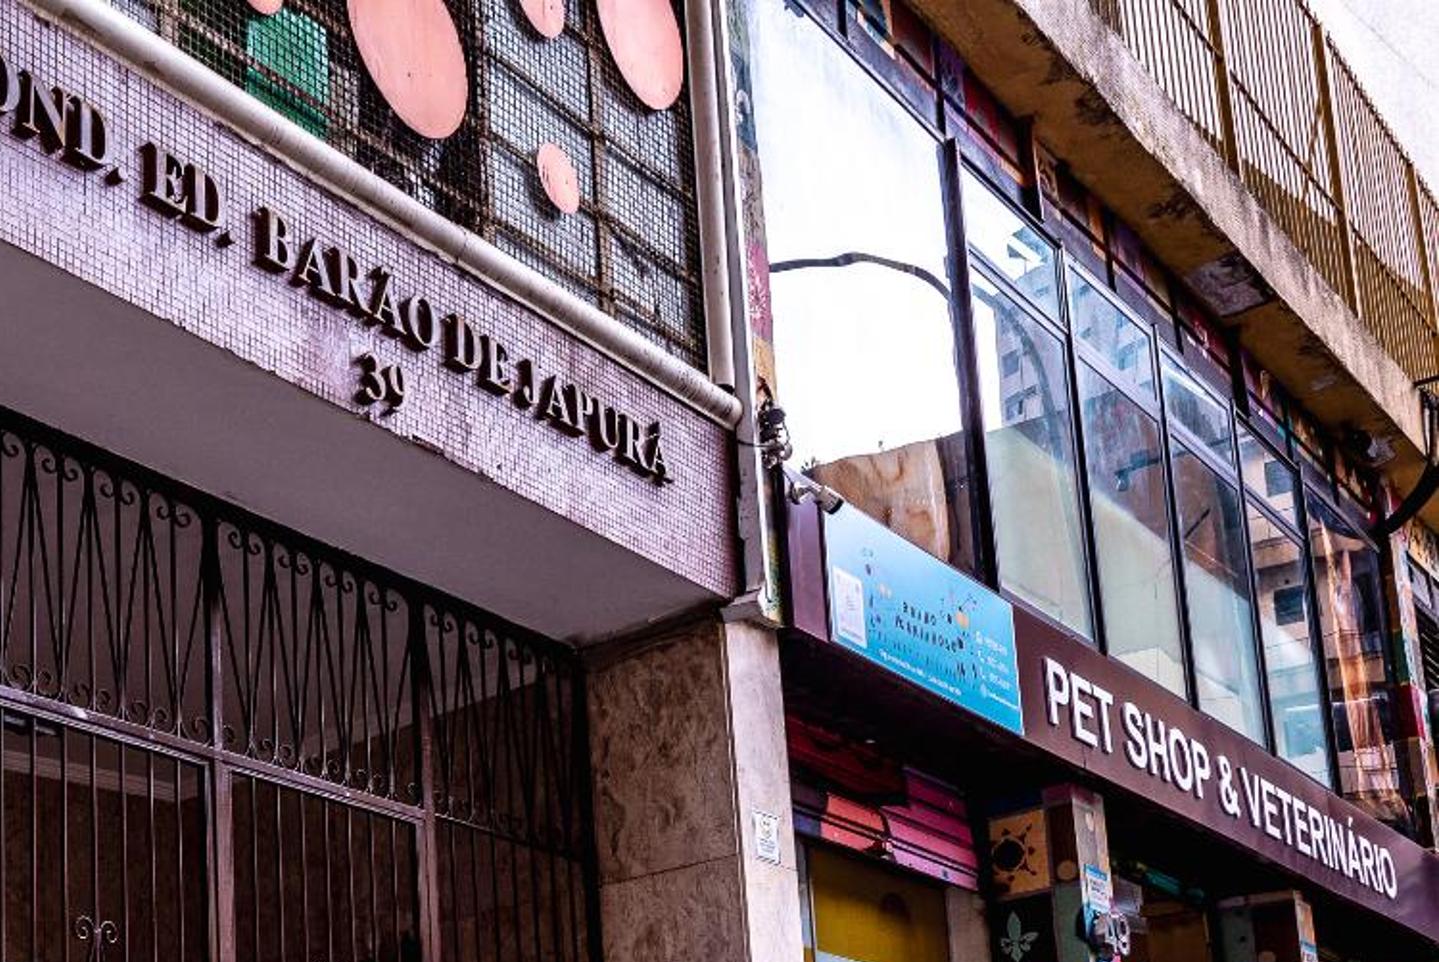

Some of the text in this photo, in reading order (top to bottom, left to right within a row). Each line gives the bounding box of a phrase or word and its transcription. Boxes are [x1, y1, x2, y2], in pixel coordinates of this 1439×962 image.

[139, 141, 236, 247] ED.
[254, 204, 442, 352] BARÃO
[440, 312, 515, 394] DE
[515, 358, 673, 488] JAPURÁ
[355, 352, 408, 418] 39
[1044, 657, 1114, 755] PET
[1123, 702, 1211, 799] SHOP
[1217, 755, 1241, 818] &
[1241, 769, 1397, 900] VETERINÁRIO
